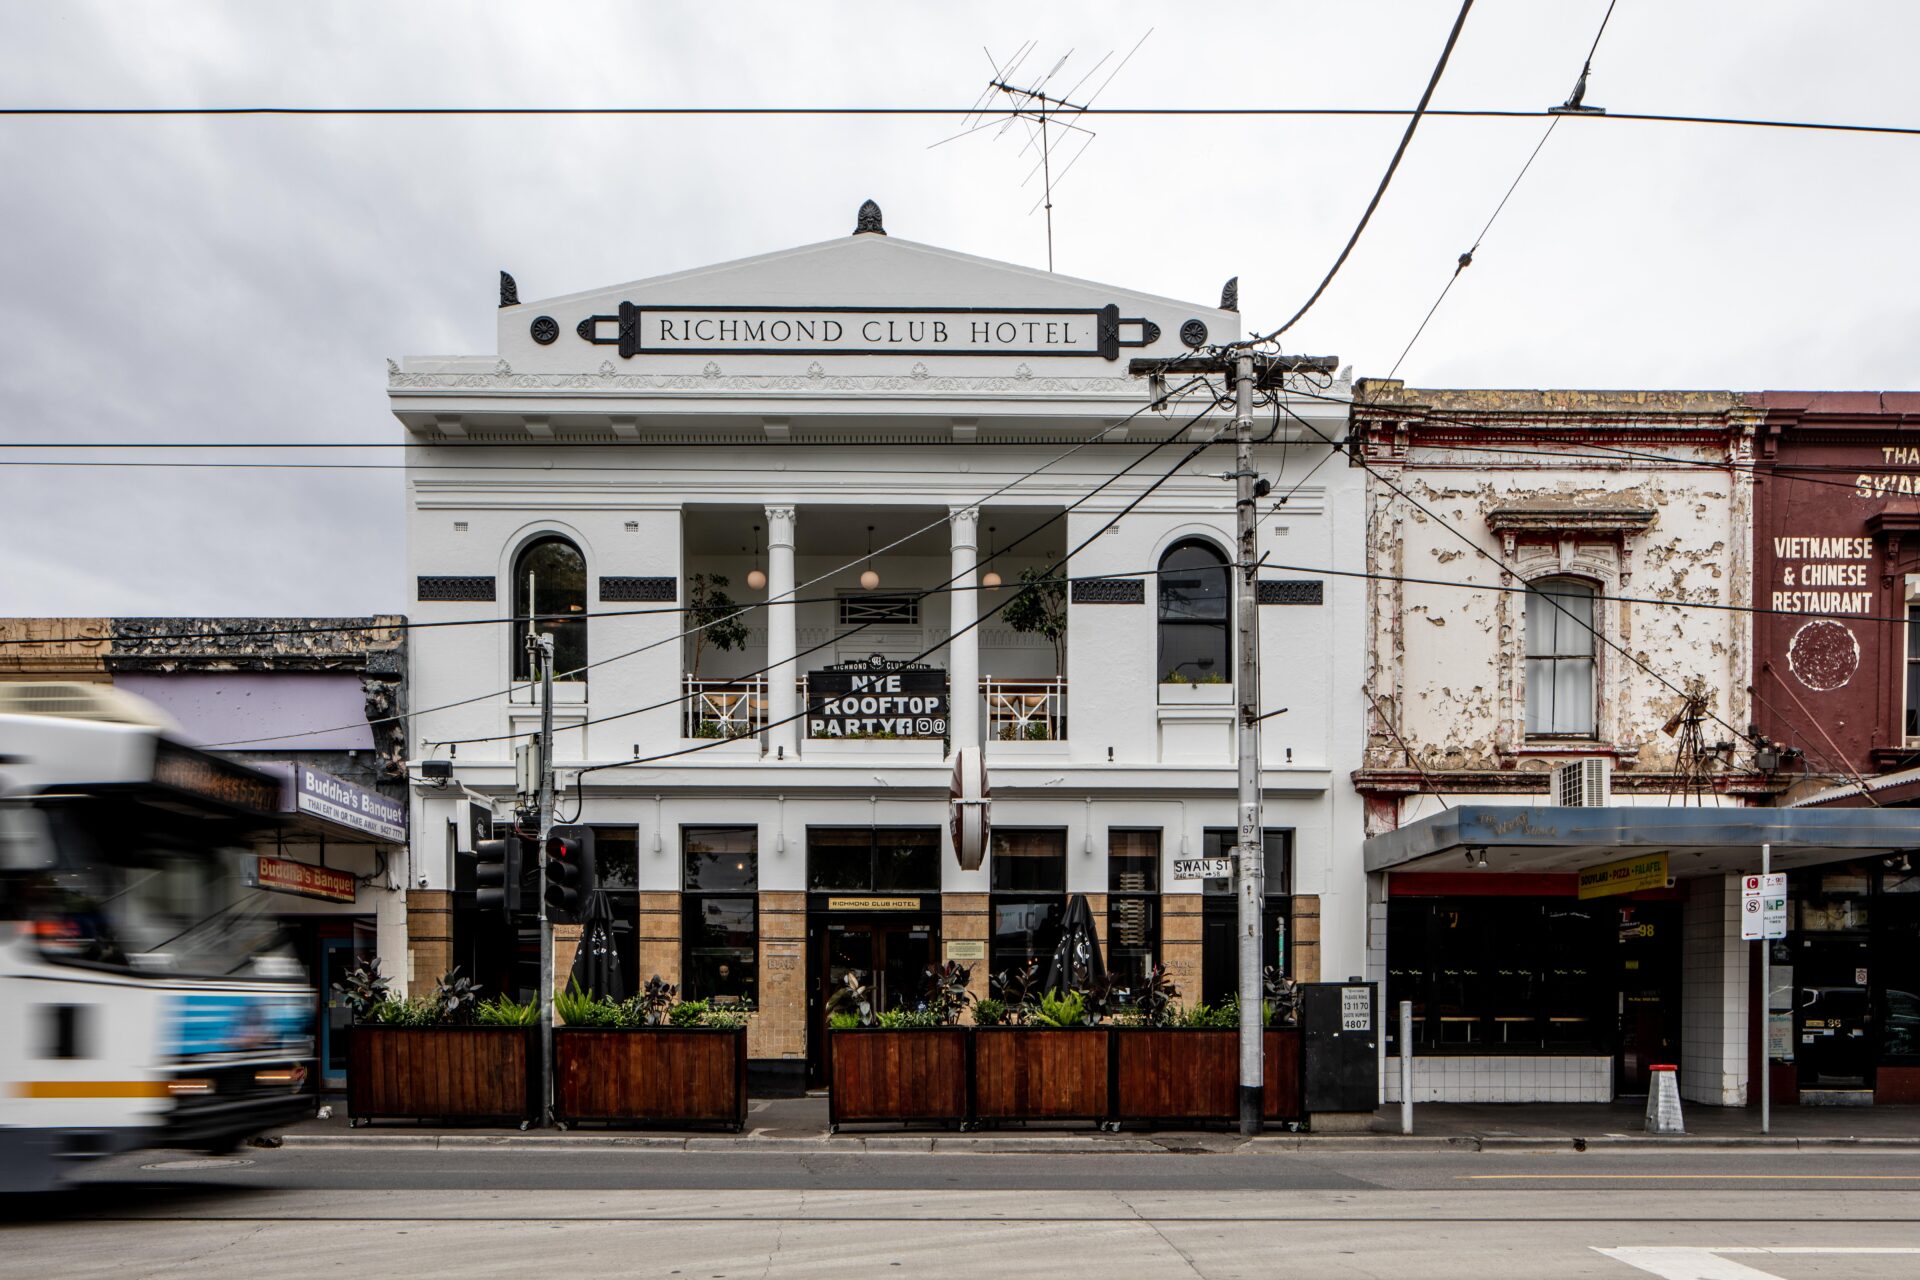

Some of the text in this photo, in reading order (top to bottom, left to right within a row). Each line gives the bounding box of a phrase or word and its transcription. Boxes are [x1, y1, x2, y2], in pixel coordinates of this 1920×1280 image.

[659, 319, 1077, 344] RICHMOND CLUB HOTEL
[1774, 537, 1873, 559] VIETNAMESE
[1783, 564, 1867, 586] & CHINESE
[1772, 591, 1873, 614] RESTAURANT
[851, 675, 901, 693] NYE
[811, 718, 897, 737] PARTY
[306, 771, 359, 809] Buddha's
[361, 794, 403, 824] Banquet
[308, 798, 323, 812] THAI
[323, 805, 333, 817] EAT
[333, 809, 340, 819] IN
[341, 810, 348, 821] OR
[349, 813, 363, 828] TAKE
[364, 819, 378, 833] AWAY
[260, 858, 311, 884] Buddha's
[314, 868, 355, 893] Banquet
[1175, 859, 1230, 873] SWAN ST
[1580, 860, 1662, 886] SOUVLAKI PIZZA FALAFEL
[1640, 924, 1655, 937] 98
[767, 959, 796, 970] BAR
[1343, 1002, 1369, 1010] 13 11 70
[1344, 1020, 1368, 1029] 4807
